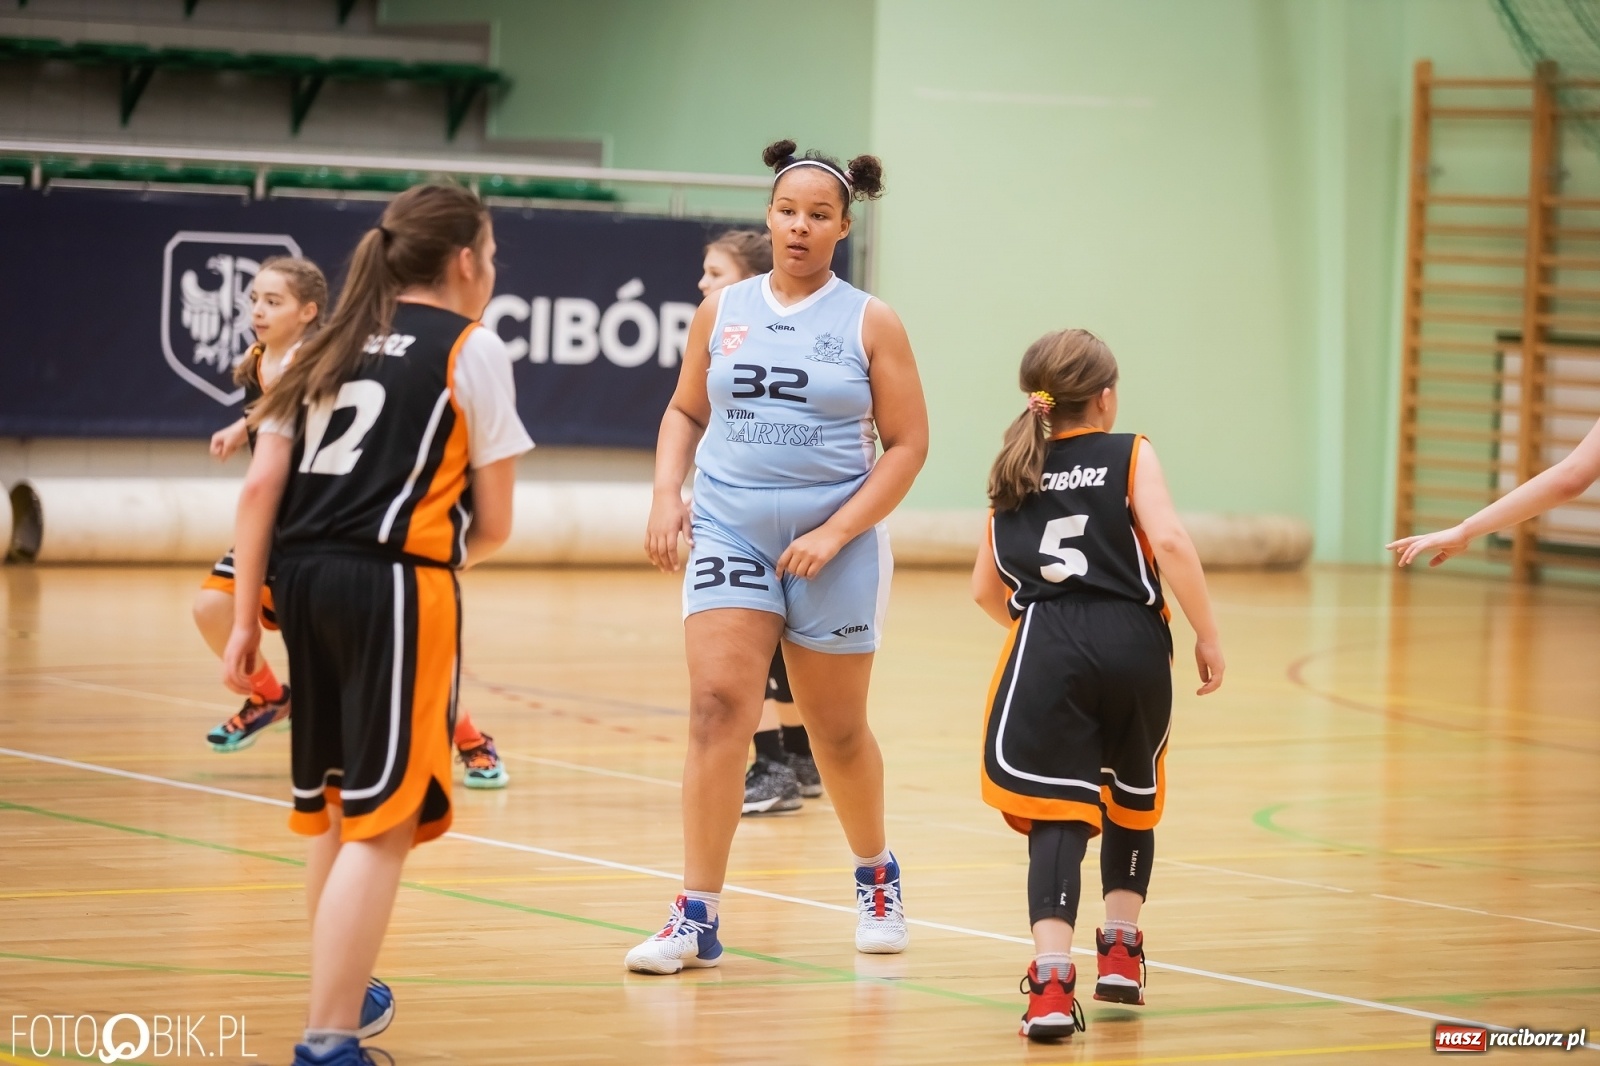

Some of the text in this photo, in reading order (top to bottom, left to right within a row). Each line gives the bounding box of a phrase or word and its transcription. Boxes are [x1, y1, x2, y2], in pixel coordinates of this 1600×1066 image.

[731, 363, 809, 403] 32
[299, 379, 386, 475] 12
[726, 409, 755, 420] Willa
[1039, 514, 1089, 583] 5
[694, 556, 769, 591] 32
[1129, 849, 1139, 877] TARMAK
